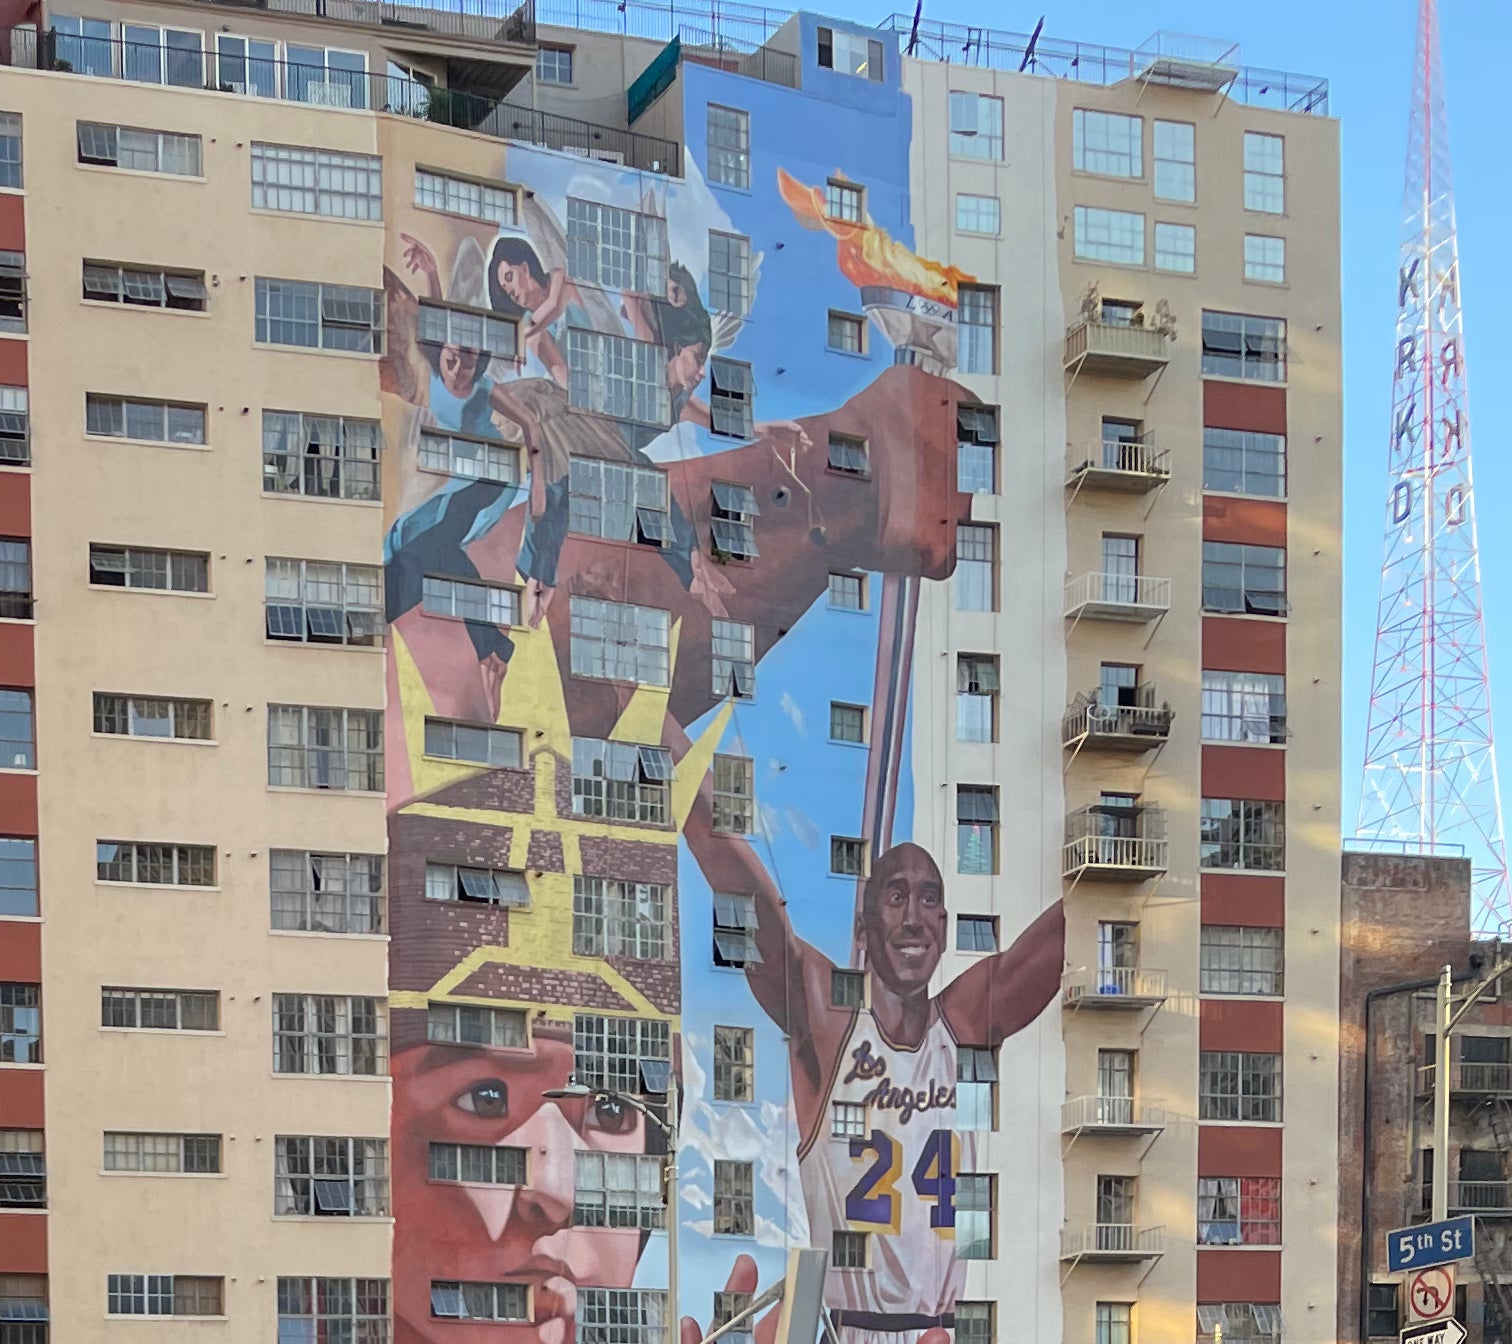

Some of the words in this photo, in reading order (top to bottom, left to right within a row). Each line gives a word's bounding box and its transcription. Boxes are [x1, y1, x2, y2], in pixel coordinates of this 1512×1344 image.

[843, 1039, 886, 1084] Los
[862, 1078, 957, 1126] Angeles
[845, 1129, 961, 1240] 24
[1399, 1233, 1433, 1264] 5th
[1441, 1228, 1462, 1252] St
